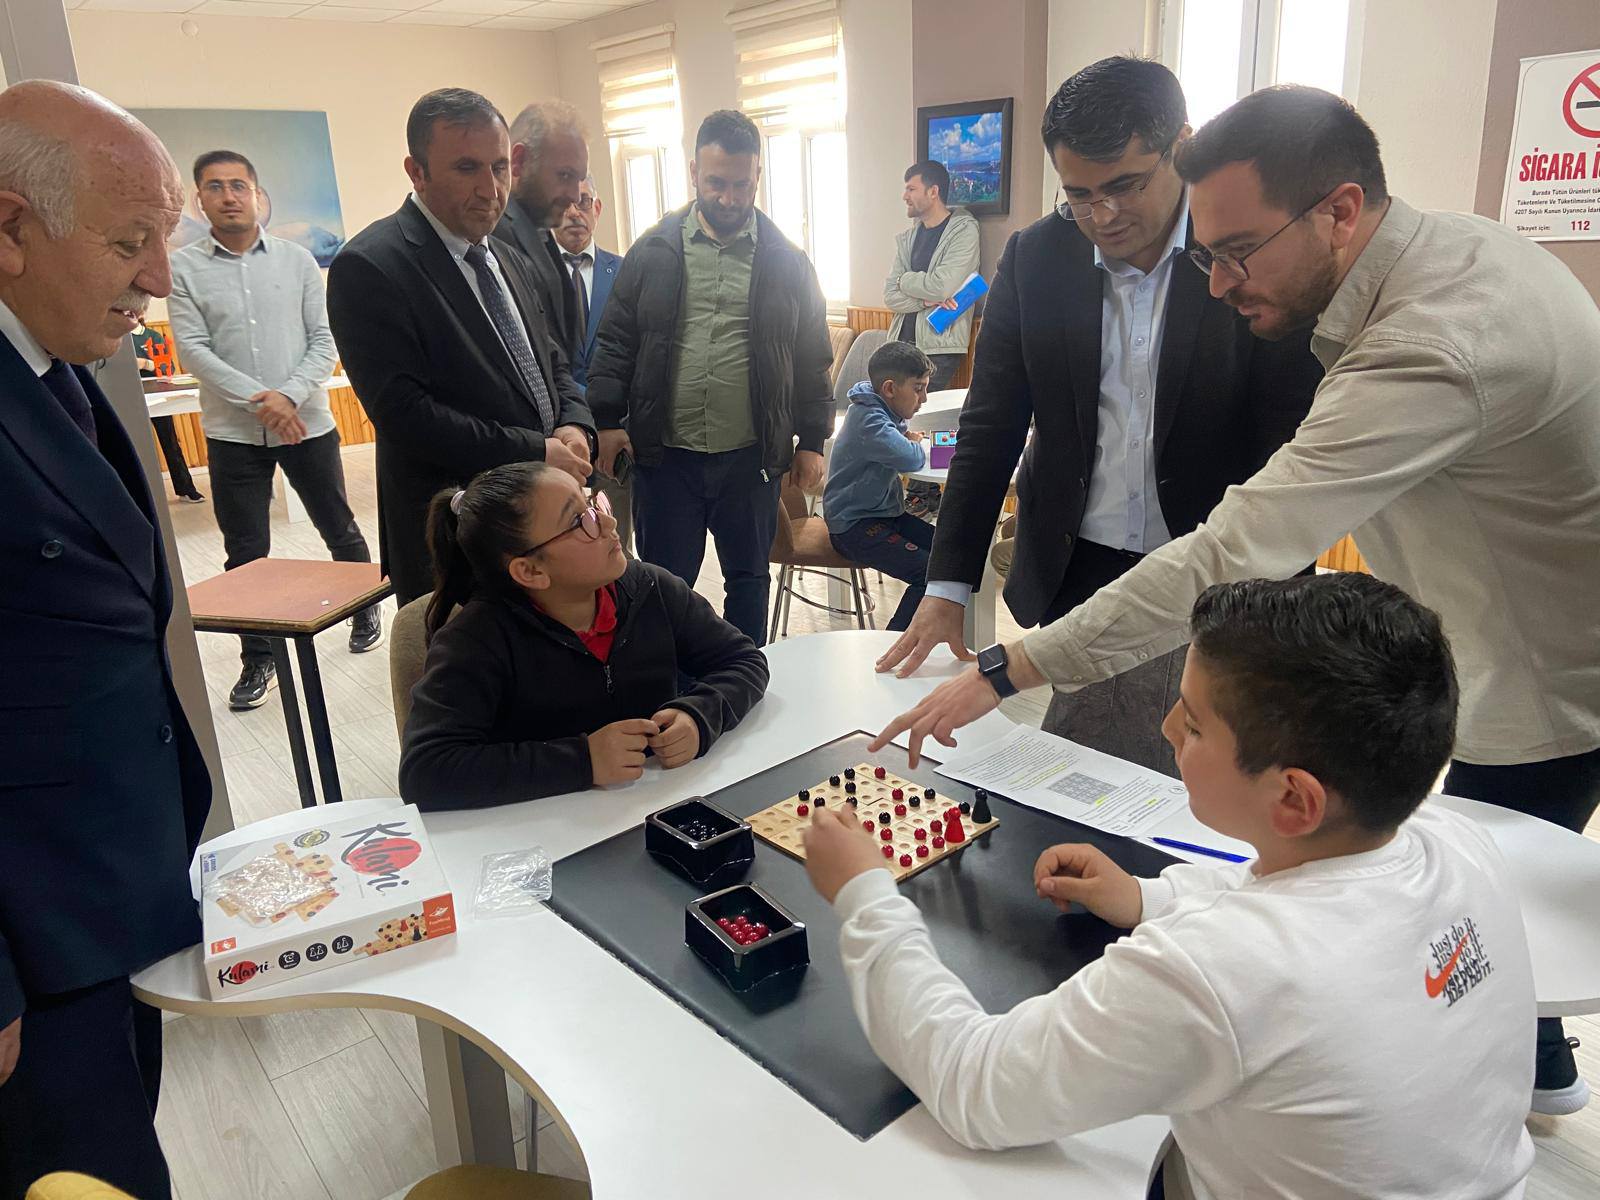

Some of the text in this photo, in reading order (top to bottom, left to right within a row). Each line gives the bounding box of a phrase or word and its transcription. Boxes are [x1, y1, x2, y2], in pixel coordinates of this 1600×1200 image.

[1519, 147, 1586, 182] SİGARA
[1562, 207, 1587, 215] Uyarınca
[1571, 220, 1590, 231] 112
[341, 821, 410, 893] Kulami
[217, 961, 269, 988] Kulami
